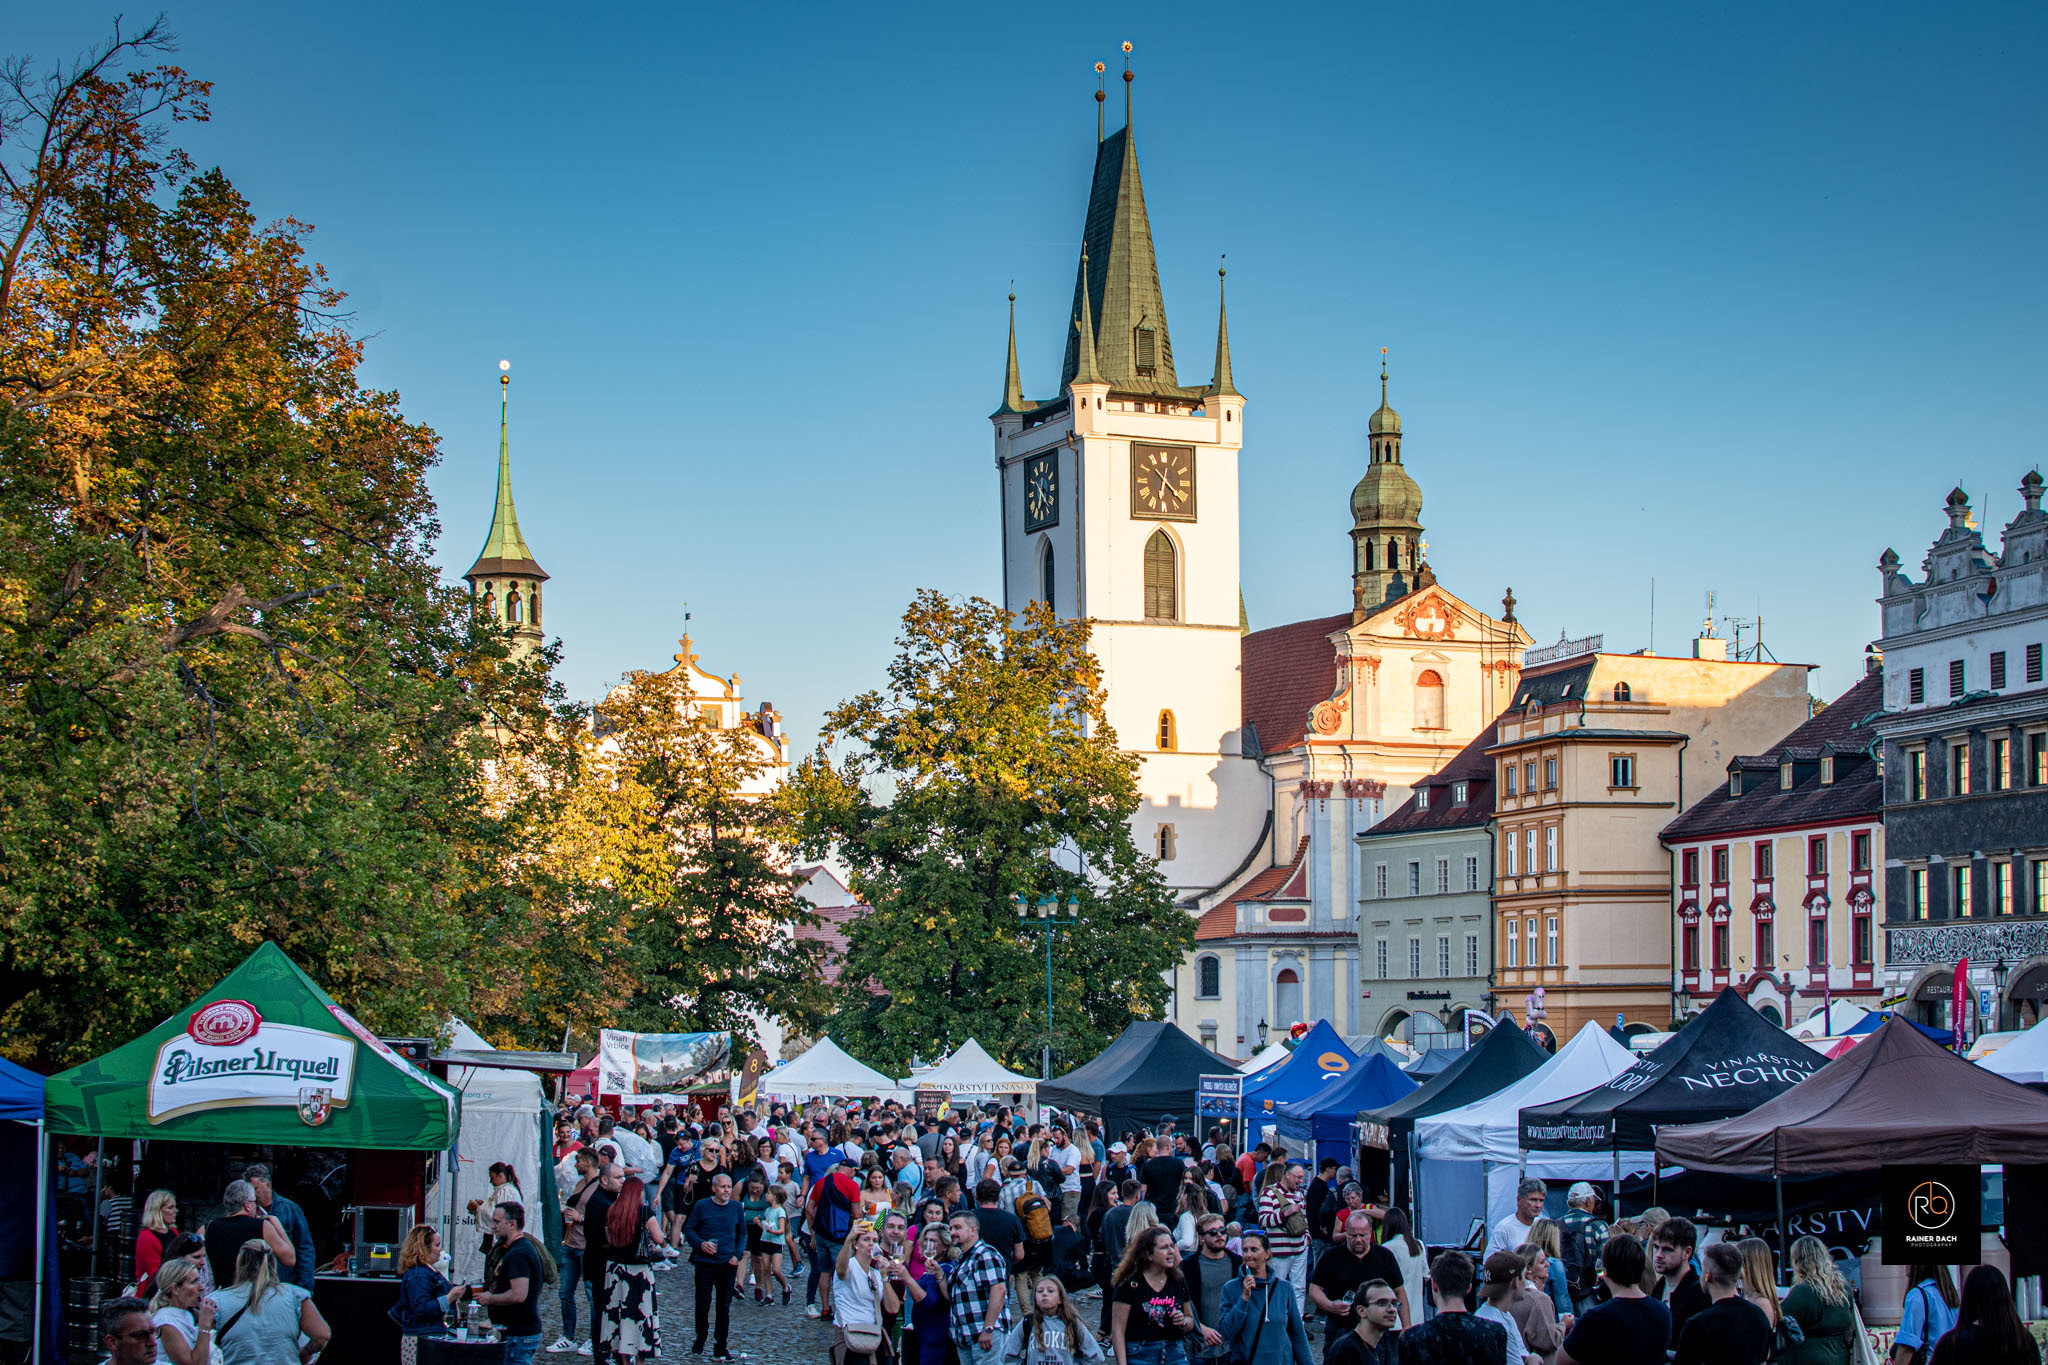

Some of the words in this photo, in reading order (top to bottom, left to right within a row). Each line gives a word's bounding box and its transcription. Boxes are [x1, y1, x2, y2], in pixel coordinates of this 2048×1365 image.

[163, 1049, 254, 1086] Pilsner
[253, 1047, 339, 1081] Urquell
[750, 1058, 758, 1073] 8
